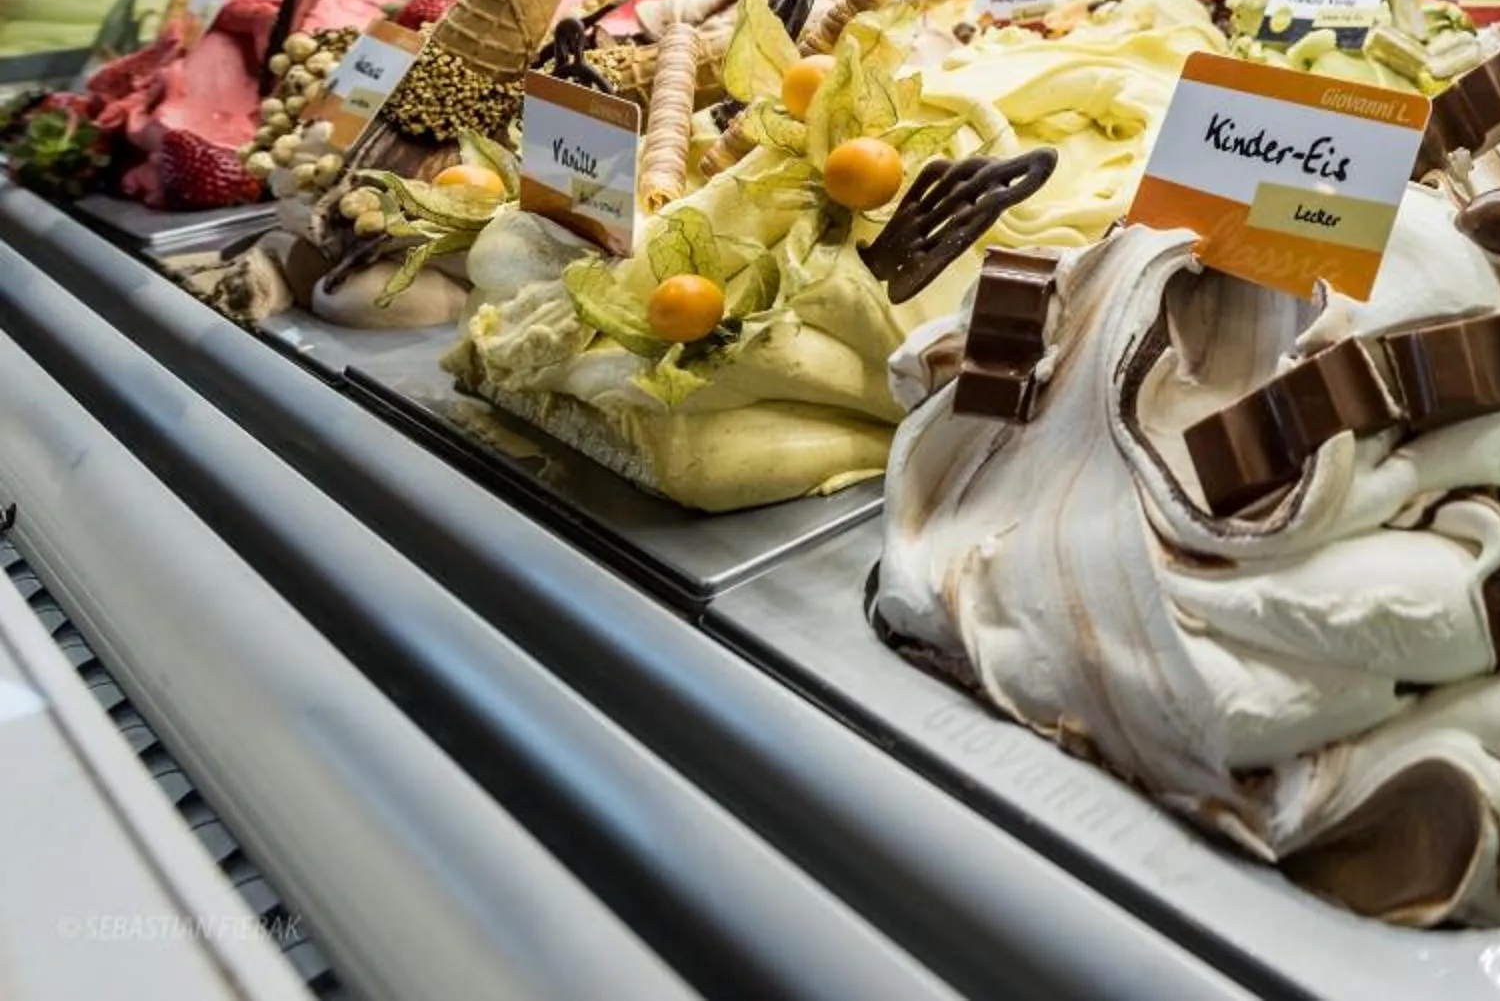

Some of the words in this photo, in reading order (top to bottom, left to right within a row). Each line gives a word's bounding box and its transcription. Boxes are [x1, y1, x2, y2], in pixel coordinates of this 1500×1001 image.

[553, 137, 599, 180] Vanille
[1203, 111, 1352, 183] Kinder-Eis
[1293, 203, 1342, 228] Lecker
